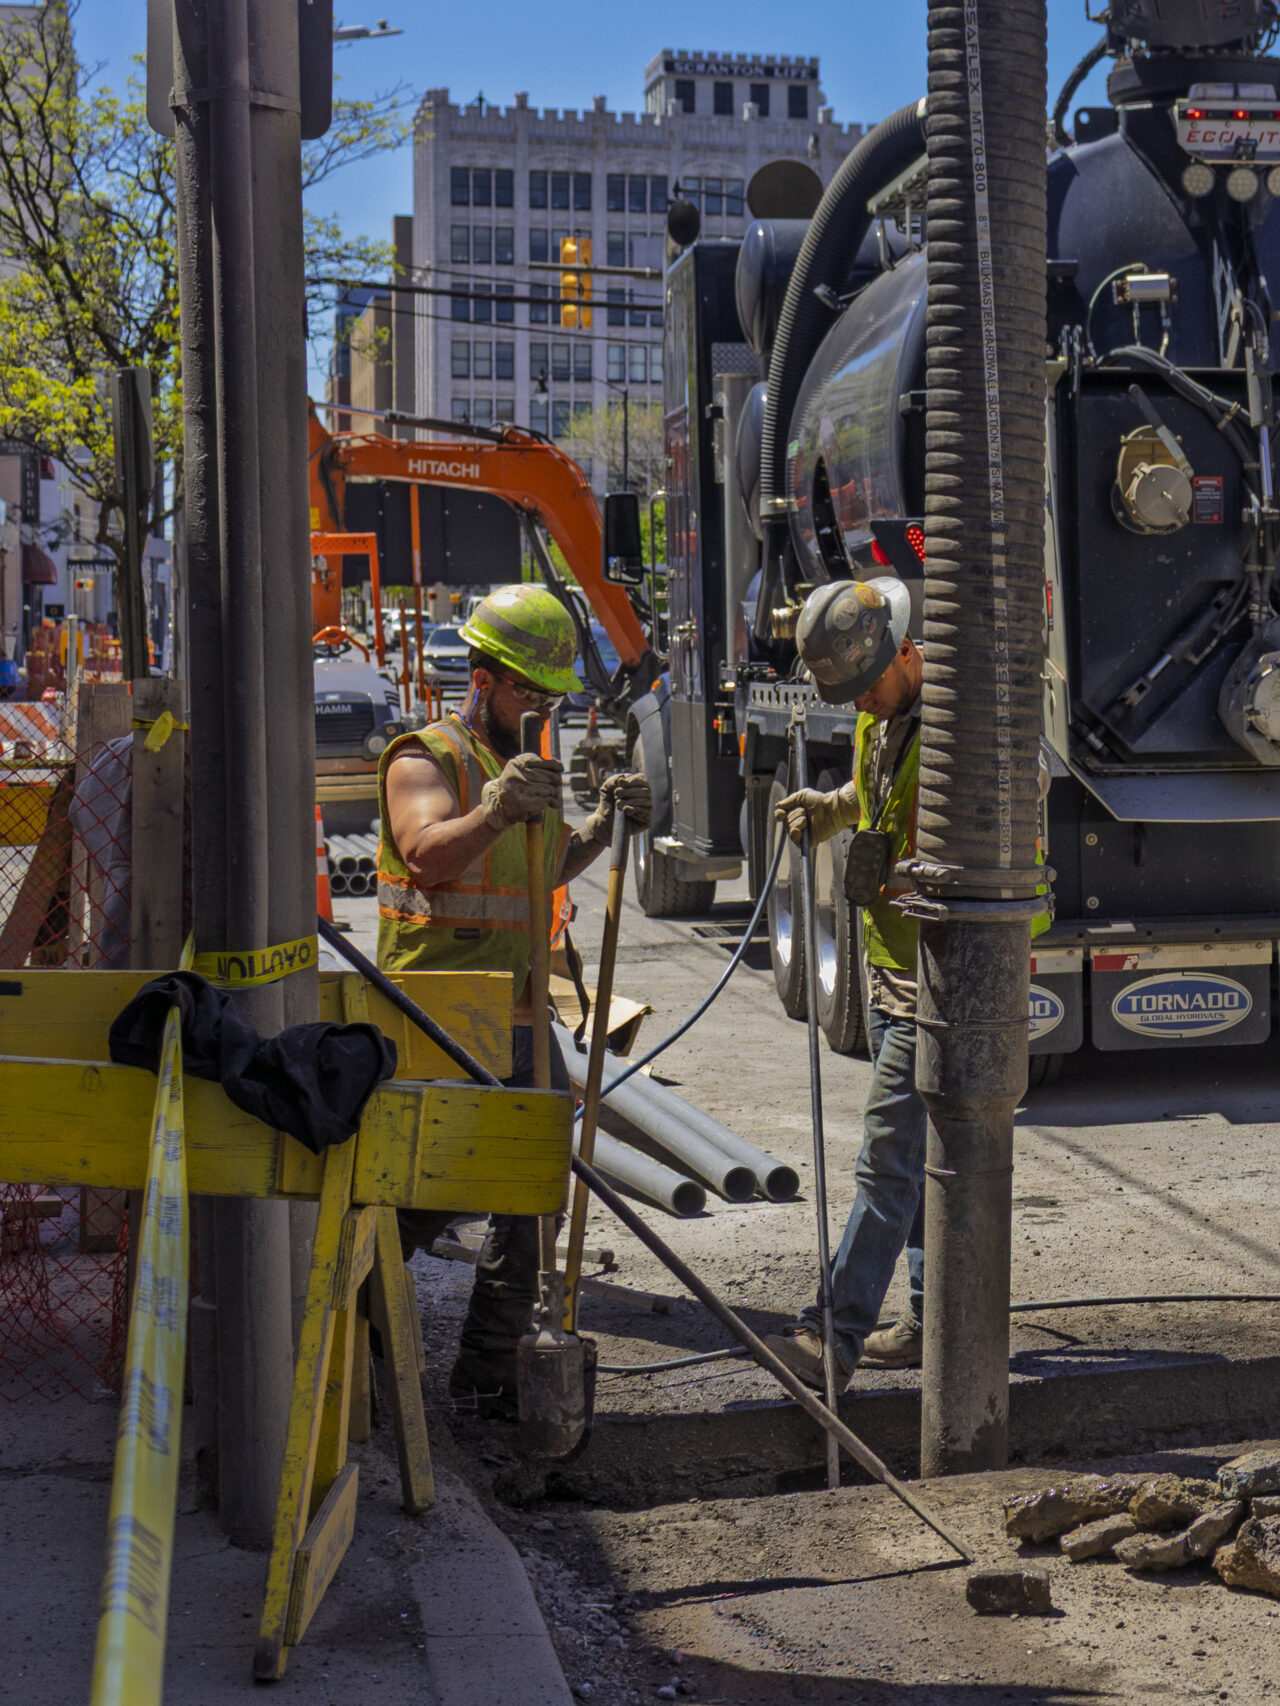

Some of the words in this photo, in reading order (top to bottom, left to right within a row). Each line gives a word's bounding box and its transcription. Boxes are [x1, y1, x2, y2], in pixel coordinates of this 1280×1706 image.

[673, 61, 765, 77] SCRANTON
[775, 67, 811, 80] LIFE
[971, 111, 986, 193] MT70-800
[984, 328, 997, 392] HARDWALL
[988, 394, 1000, 444] SUCTION
[990, 446, 1000, 459] 75
[408, 459, 480, 478] HITACHI
[315, 704, 352, 715] HAMM
[1127, 991, 1240, 1013] TORNADO
[1140, 1013, 1176, 1022] GLOBAL
[1176, 1011, 1225, 1021] HYDROVACS
